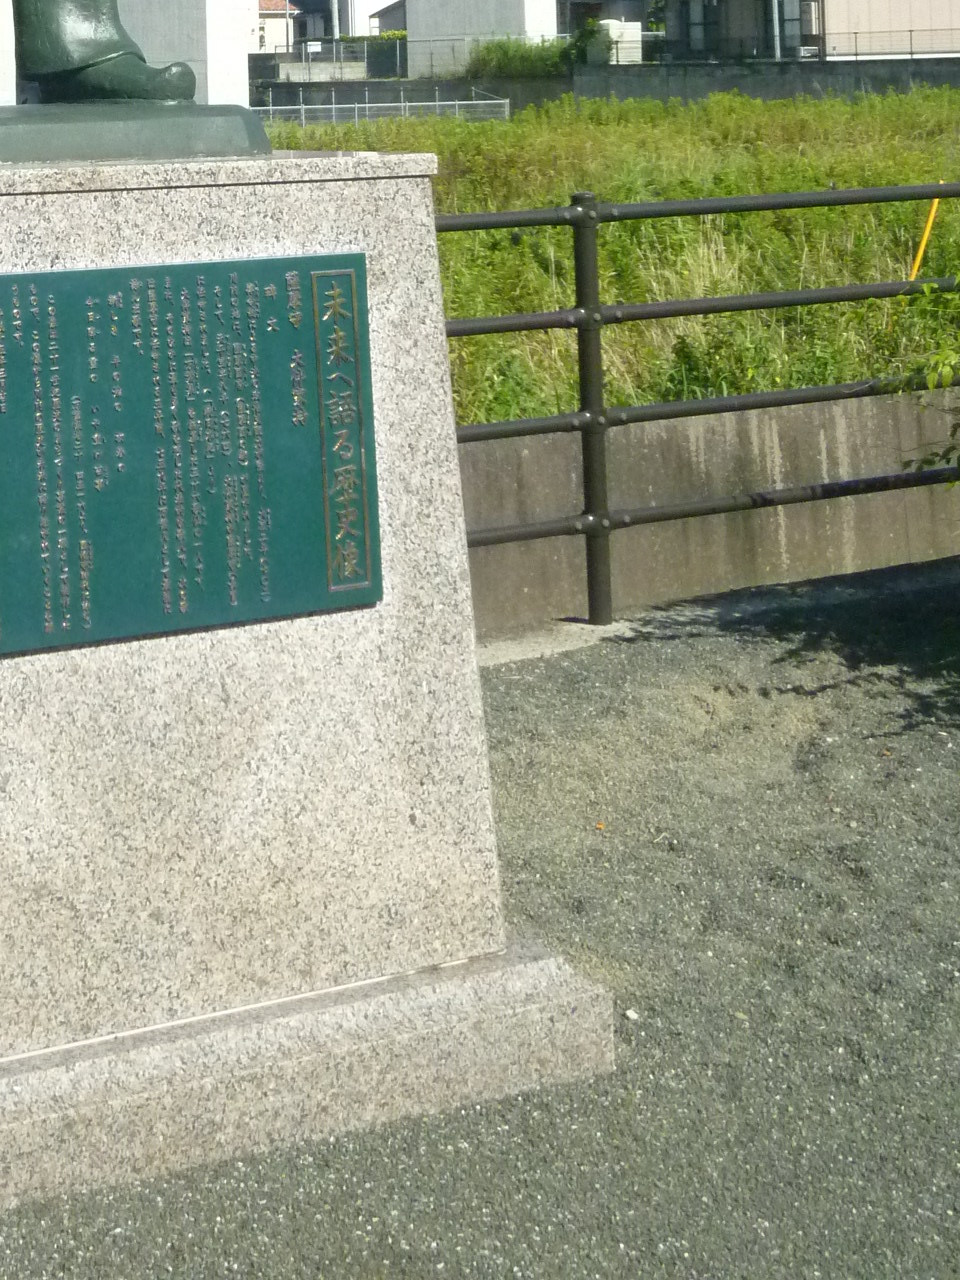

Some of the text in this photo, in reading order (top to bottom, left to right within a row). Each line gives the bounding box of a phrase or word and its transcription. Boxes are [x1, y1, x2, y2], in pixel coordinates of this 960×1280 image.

[321, 279, 364, 581] 未来へ語る歴史像
